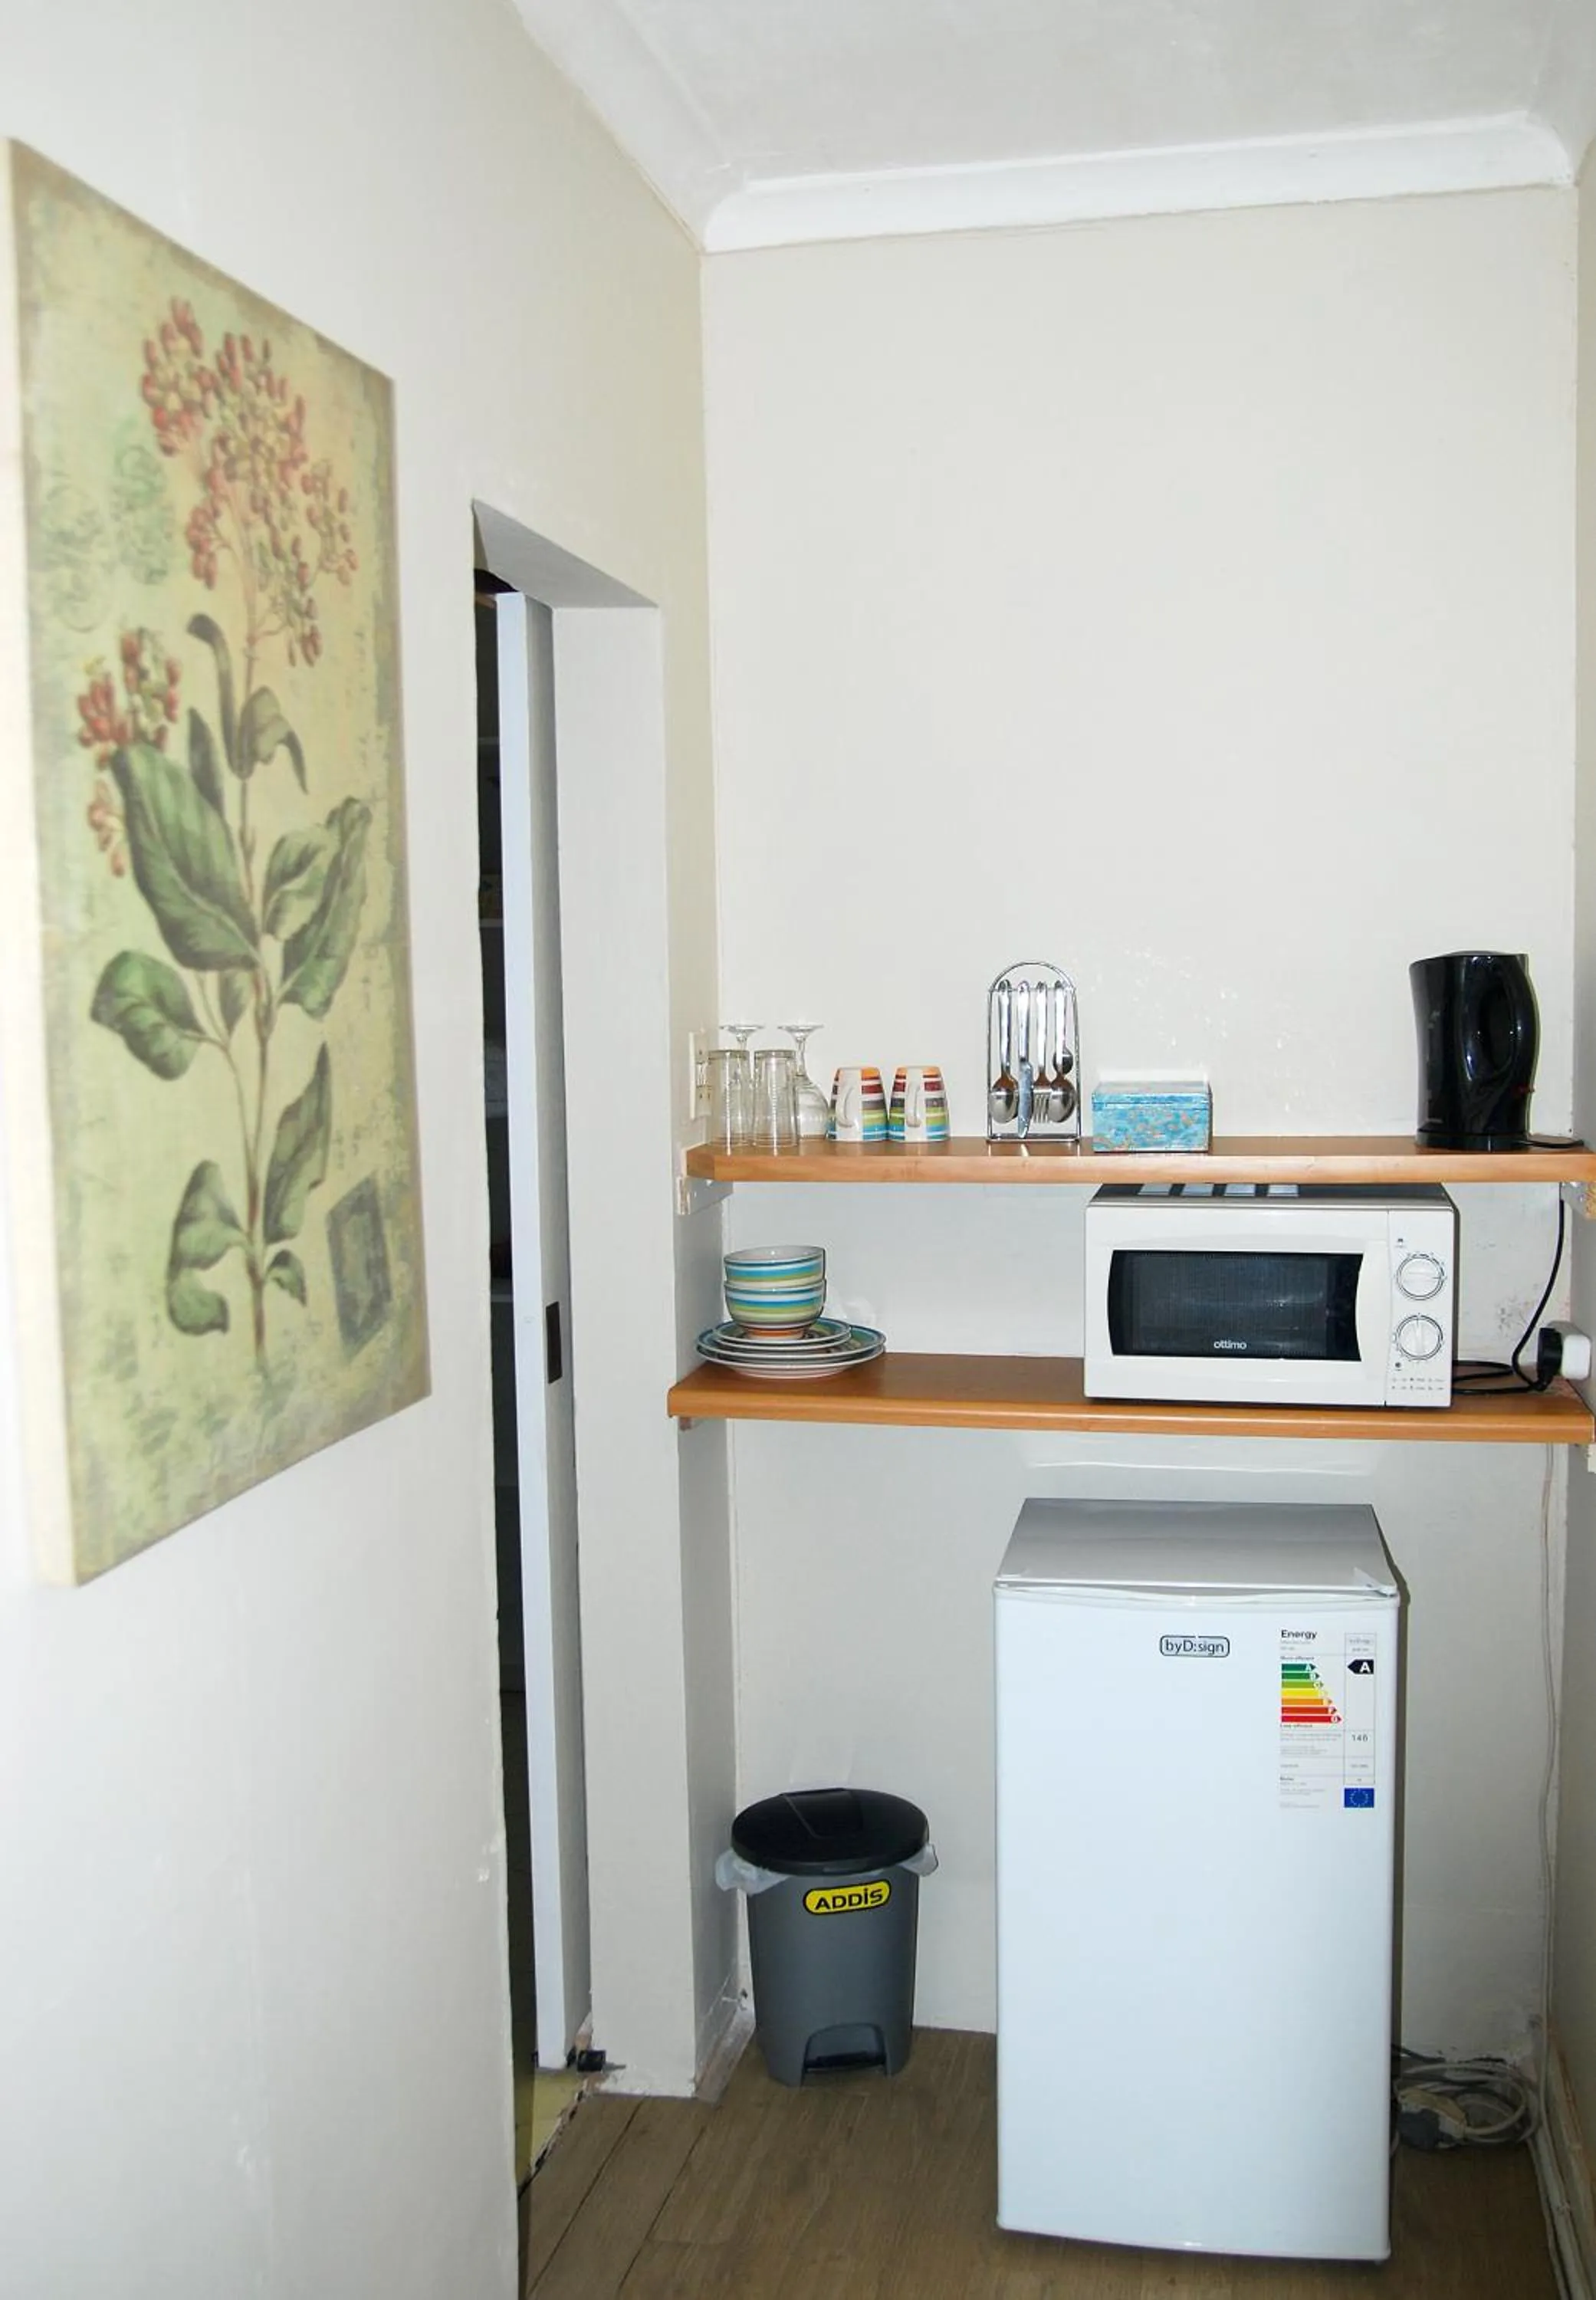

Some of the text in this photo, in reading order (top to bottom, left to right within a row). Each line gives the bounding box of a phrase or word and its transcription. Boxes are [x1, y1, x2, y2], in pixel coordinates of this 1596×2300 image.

[1213, 1340, 1247, 1349] ottimo
[1281, 1629, 1317, 1639] Energy
[1359, 1662, 1371, 1673] A
